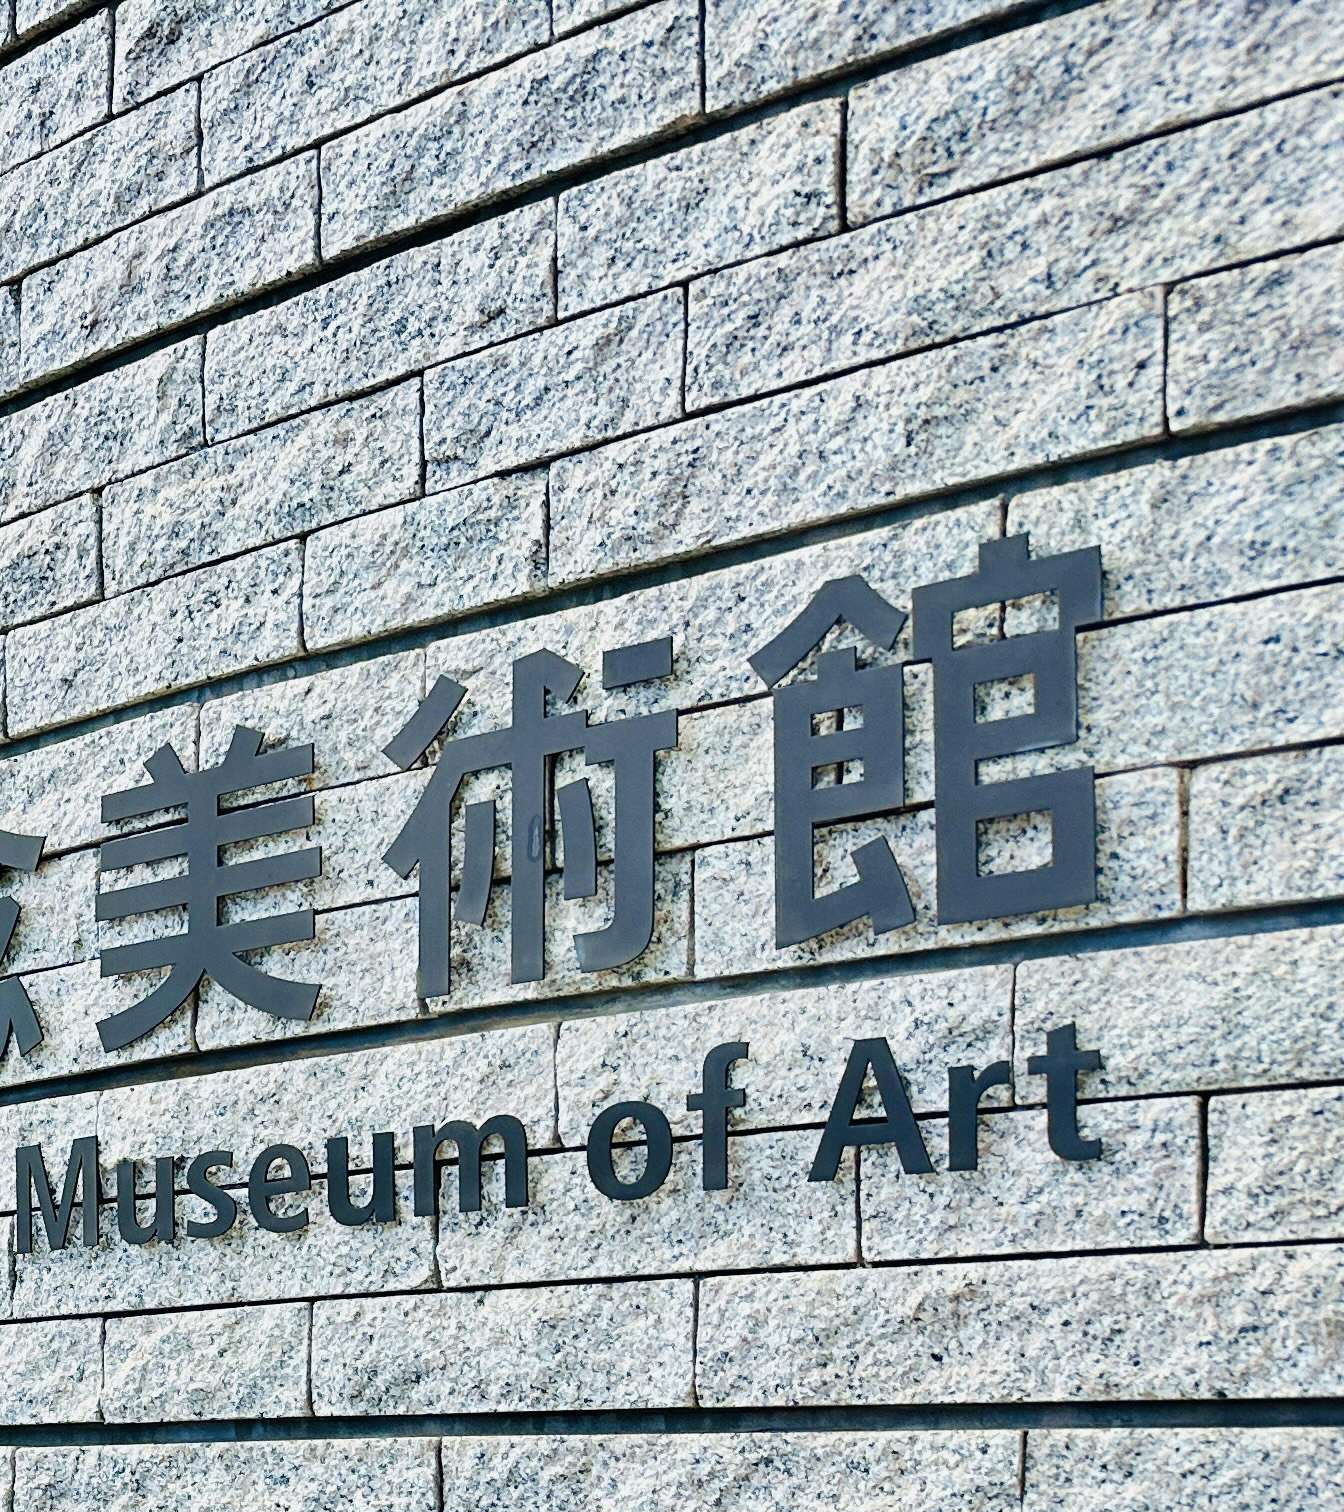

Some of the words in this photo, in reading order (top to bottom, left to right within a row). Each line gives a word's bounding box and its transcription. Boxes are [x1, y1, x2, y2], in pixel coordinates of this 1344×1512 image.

[15, 1114, 529, 1255] Museum
[585, 1042, 750, 1200] of
[808, 1022, 1102, 1182] Art
